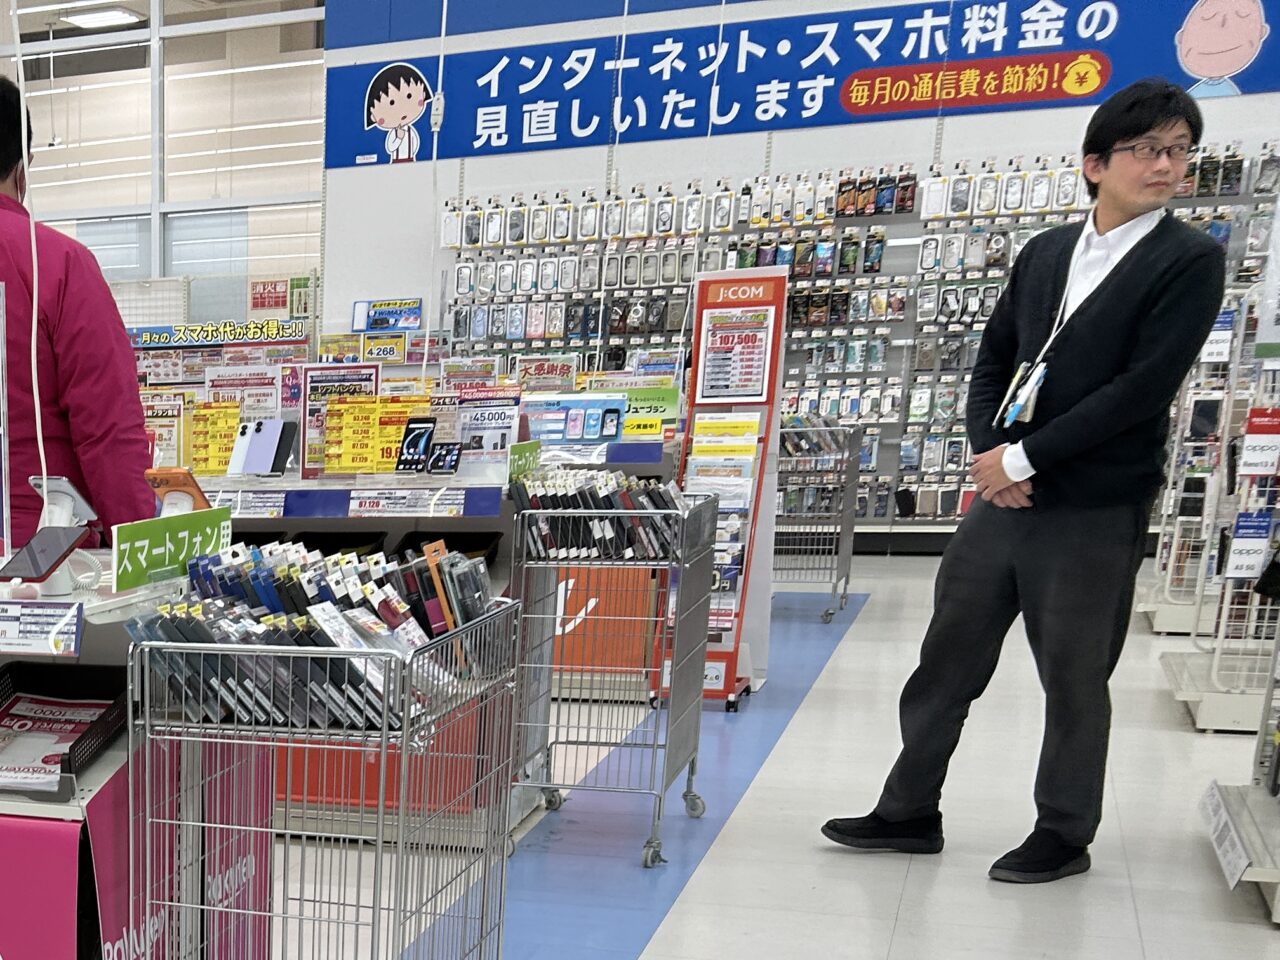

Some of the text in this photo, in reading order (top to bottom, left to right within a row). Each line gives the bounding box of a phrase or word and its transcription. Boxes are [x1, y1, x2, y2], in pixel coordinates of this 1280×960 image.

[475, 0, 1119, 98] インターネット・スマホ料金の
[848, 61, 1061, 106] 毎月の通信費を節約!
[473, 73, 835, 149] 見直しいたします
[718, 287, 763, 302] J:COM
[142, 319, 304, 344] 月々のスマホ代がお得に!!
[719, 334, 758, 347] 107,500
[520, 362, 572, 379] 大感謝祭
[118, 520, 231, 575] スマートフォン用
